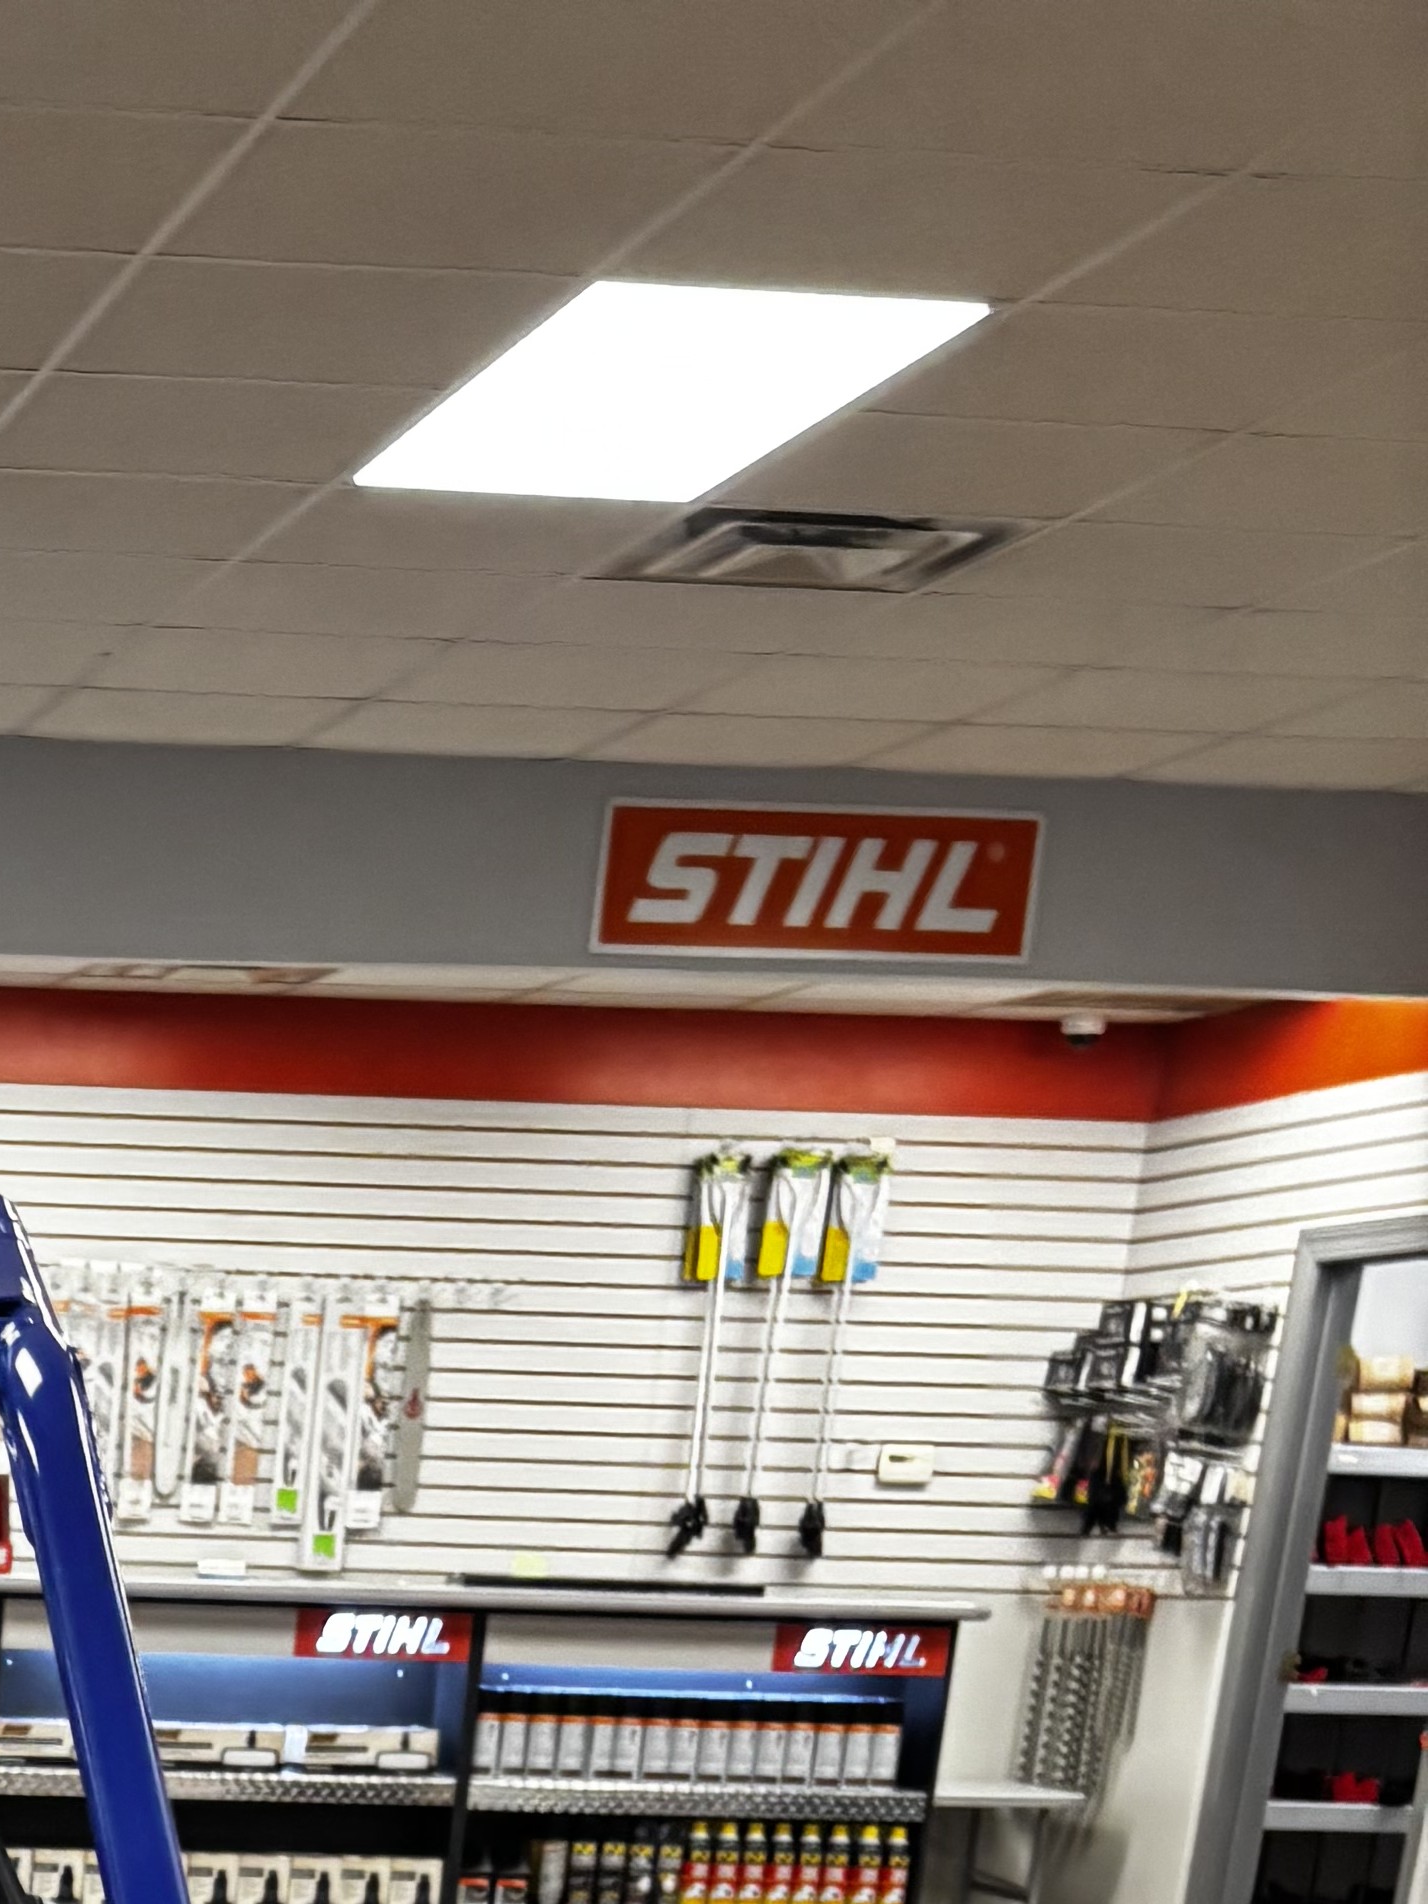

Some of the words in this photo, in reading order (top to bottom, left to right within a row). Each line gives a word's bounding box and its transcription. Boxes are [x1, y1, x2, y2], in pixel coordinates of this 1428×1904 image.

[626, 831, 999, 934] STIHL
[316, 1612, 451, 1655] STIHL
[794, 1627, 927, 1669] STIHL
